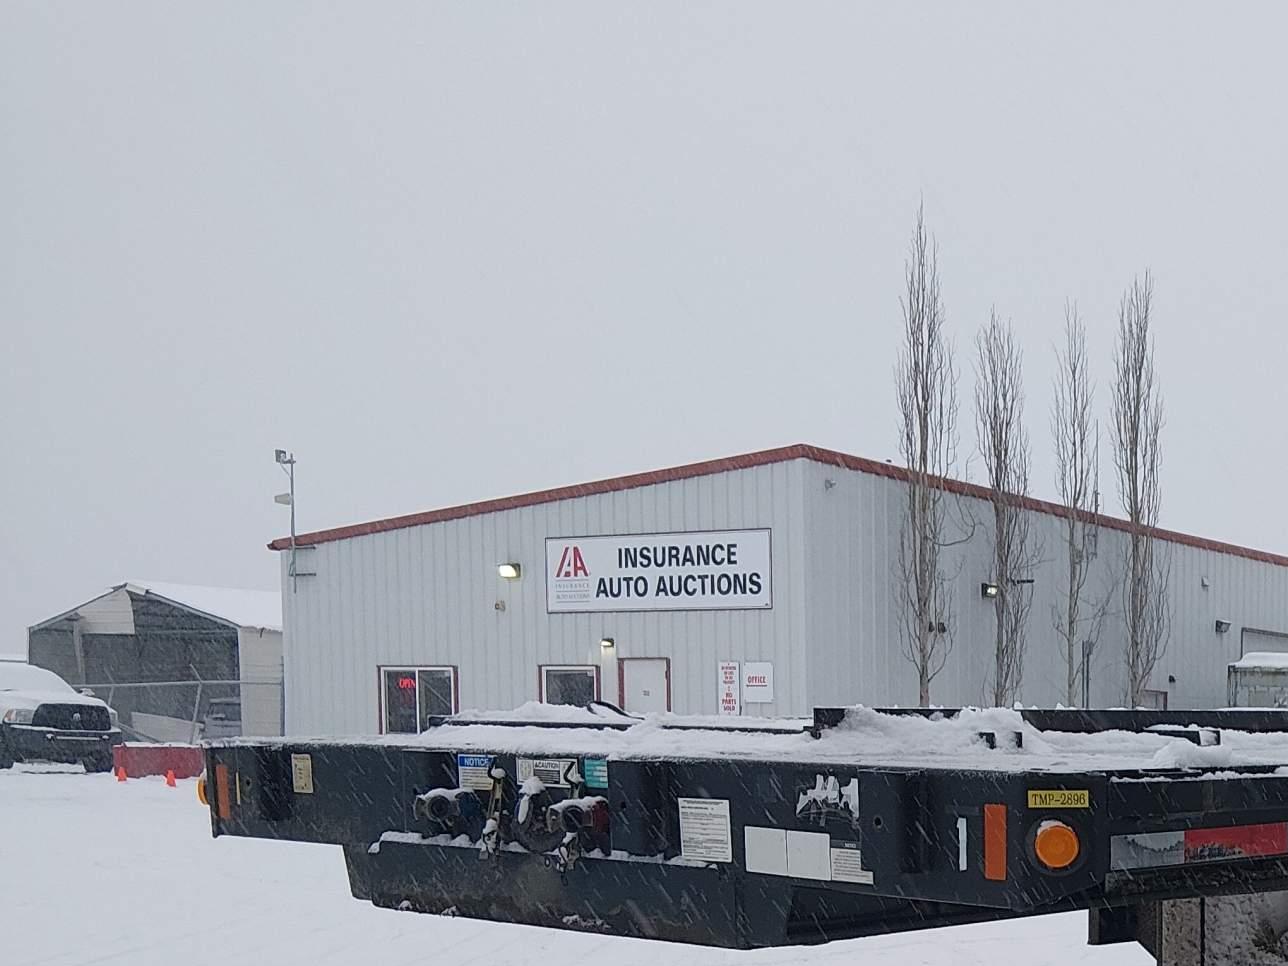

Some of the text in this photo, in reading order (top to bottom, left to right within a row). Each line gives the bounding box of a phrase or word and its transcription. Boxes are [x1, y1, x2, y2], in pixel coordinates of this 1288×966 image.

[618, 543, 738, 569] INSURANCE
[595, 572, 762, 599] AUTO AUCTIONS
[747, 676, 767, 684] OFFICE
[464, 758, 490, 767] NOTICE
[1031, 793, 1086, 806] TMP-2896
